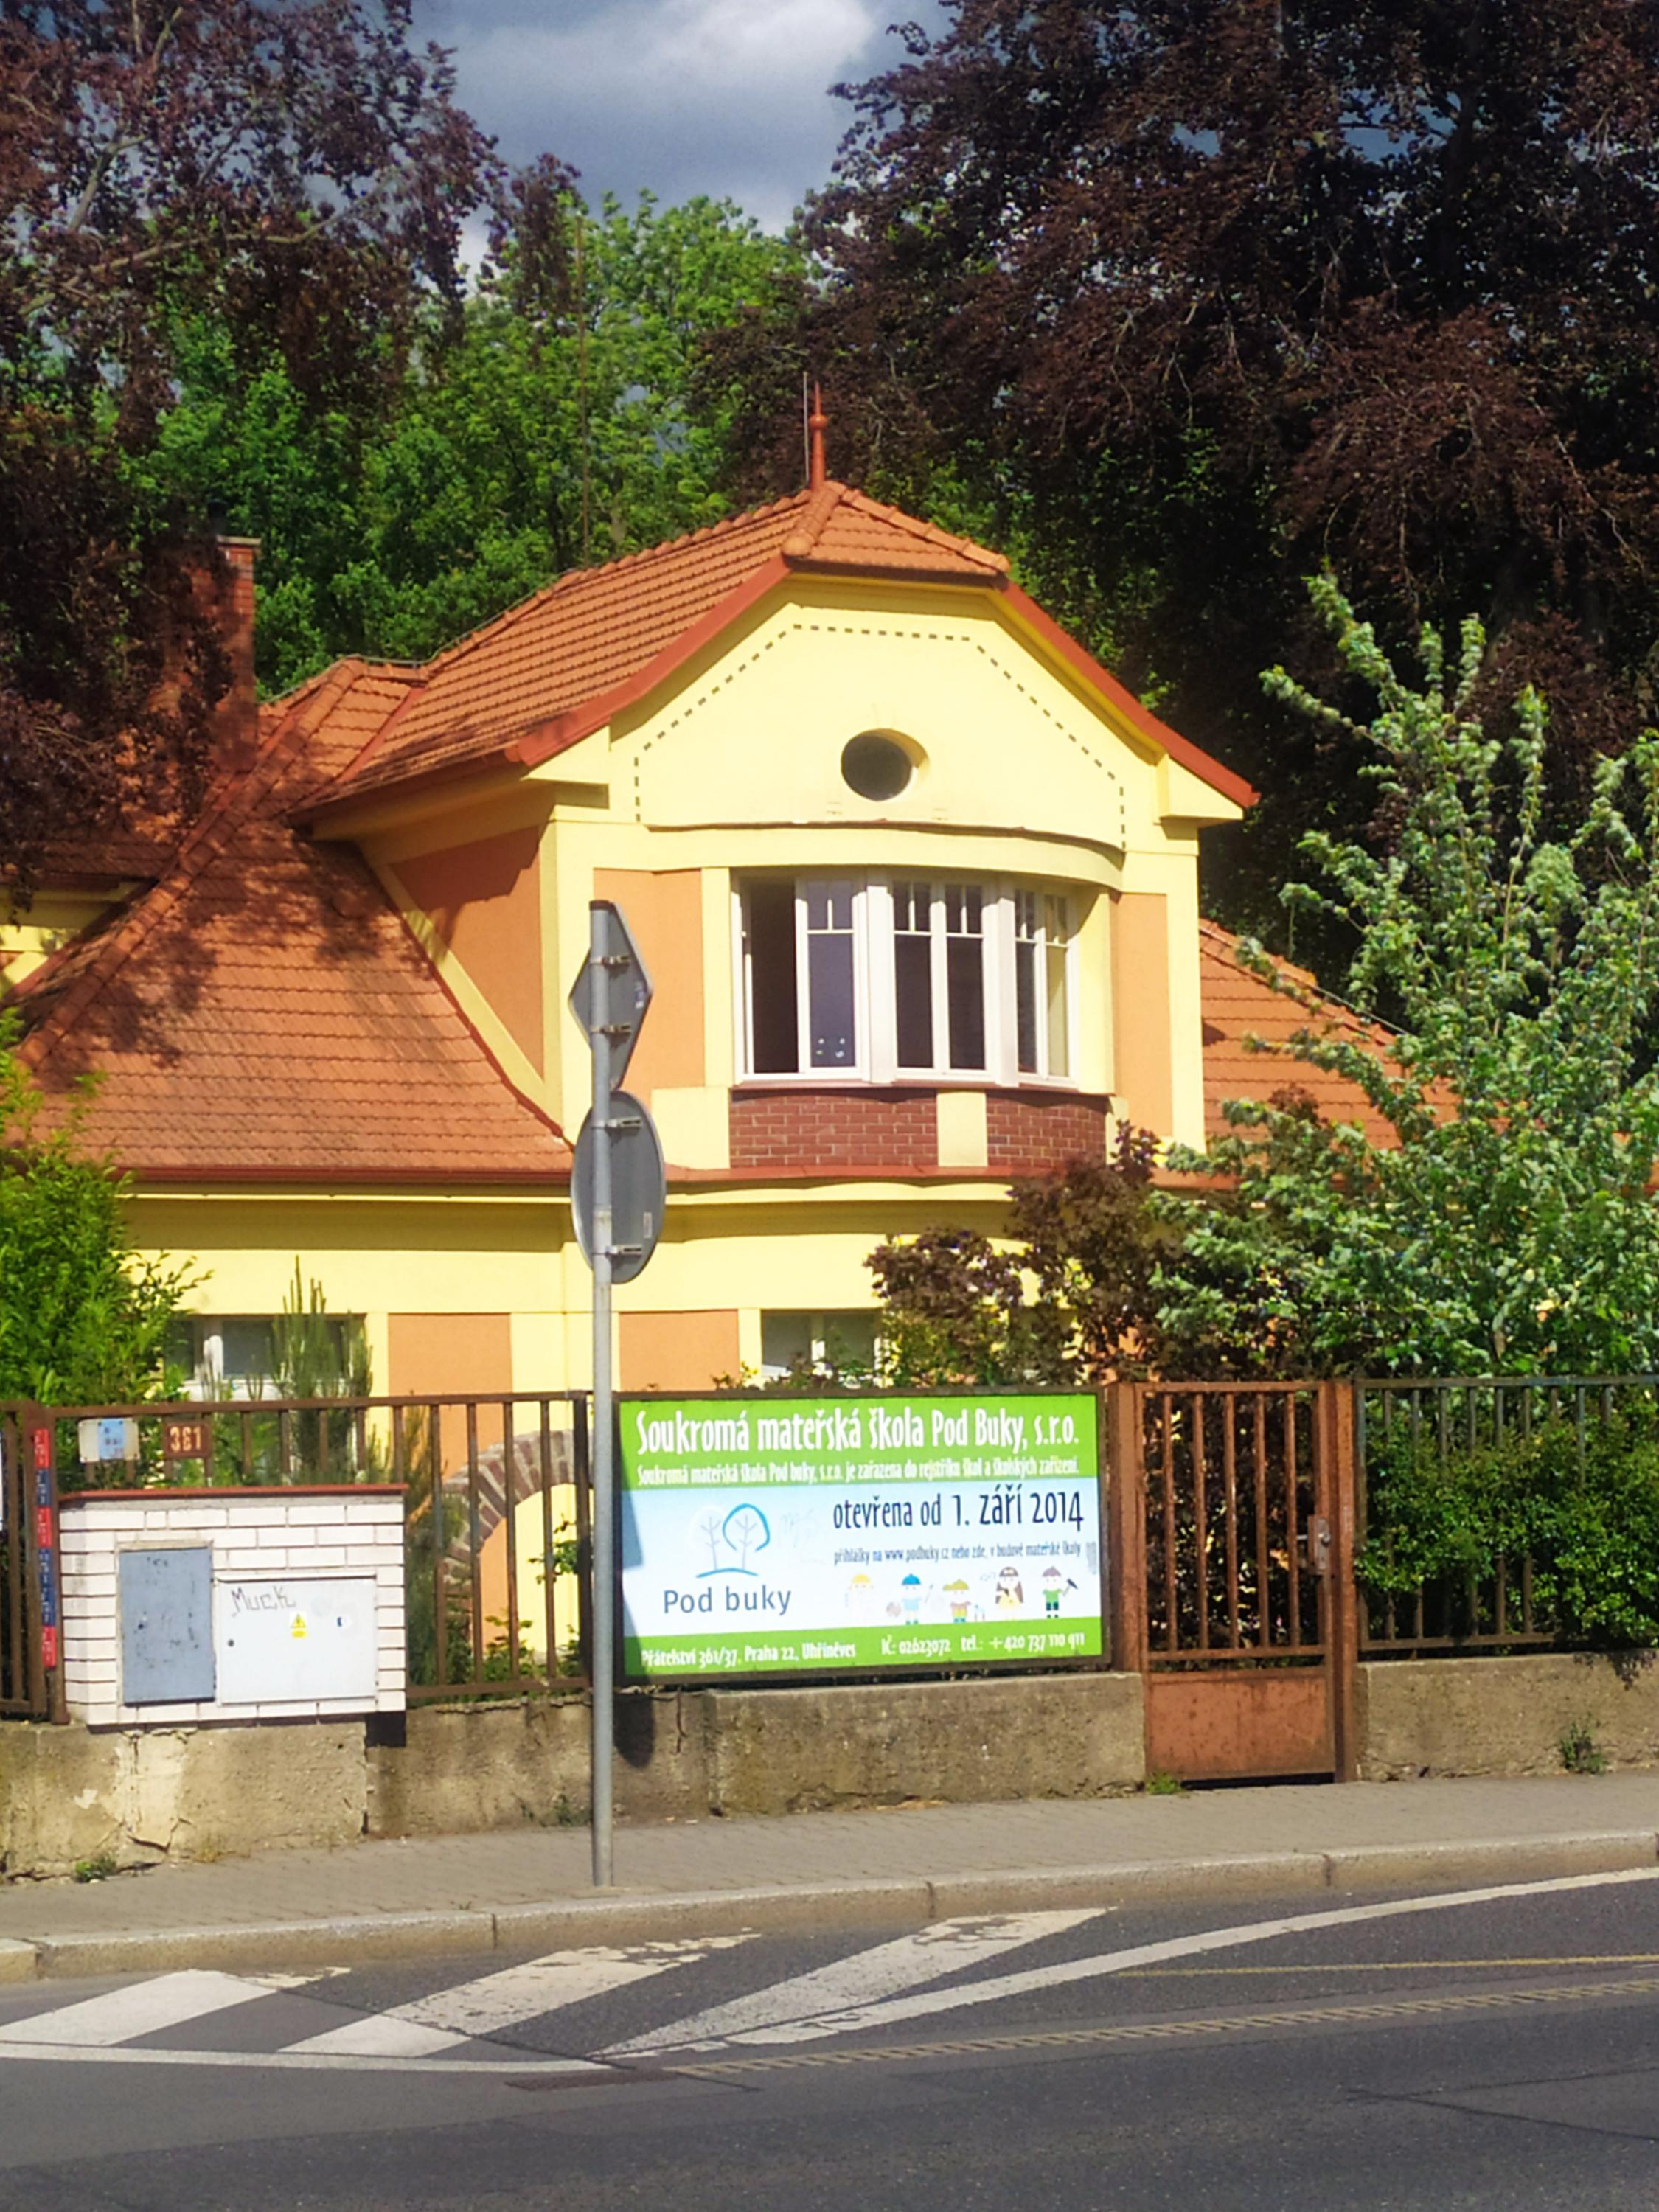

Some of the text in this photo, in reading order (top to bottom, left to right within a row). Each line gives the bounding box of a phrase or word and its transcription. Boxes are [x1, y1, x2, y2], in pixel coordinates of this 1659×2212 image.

[170, 1426, 201, 1452] 361
[636, 1406, 1079, 1455] Soukromá mateřská škola Pod Buky, s.r.o.
[637, 1464, 688, 1486] Soukromá
[691, 1463, 739, 1484] mateřská
[740, 1462, 767, 1483] škola
[769, 1461, 789, 1481] Pod
[846, 1461, 856, 1483] je
[905, 1459, 917, 1478] do
[963, 1457, 983, 1476] škol
[984, 1461, 990, 1475] a
[833, 1495, 913, 1529] otevřena
[920, 1493, 942, 1526] od
[952, 1495, 970, 1526] 1.
[979, 1483, 1023, 1526] září
[1030, 1491, 1084, 1532] 2014
[664, 1584, 791, 1616] Pod buky
[745, 1644, 779, 1662] Praha
[1027, 1634, 1046, 1652] 737
[1048, 1633, 1065, 1647] 110
